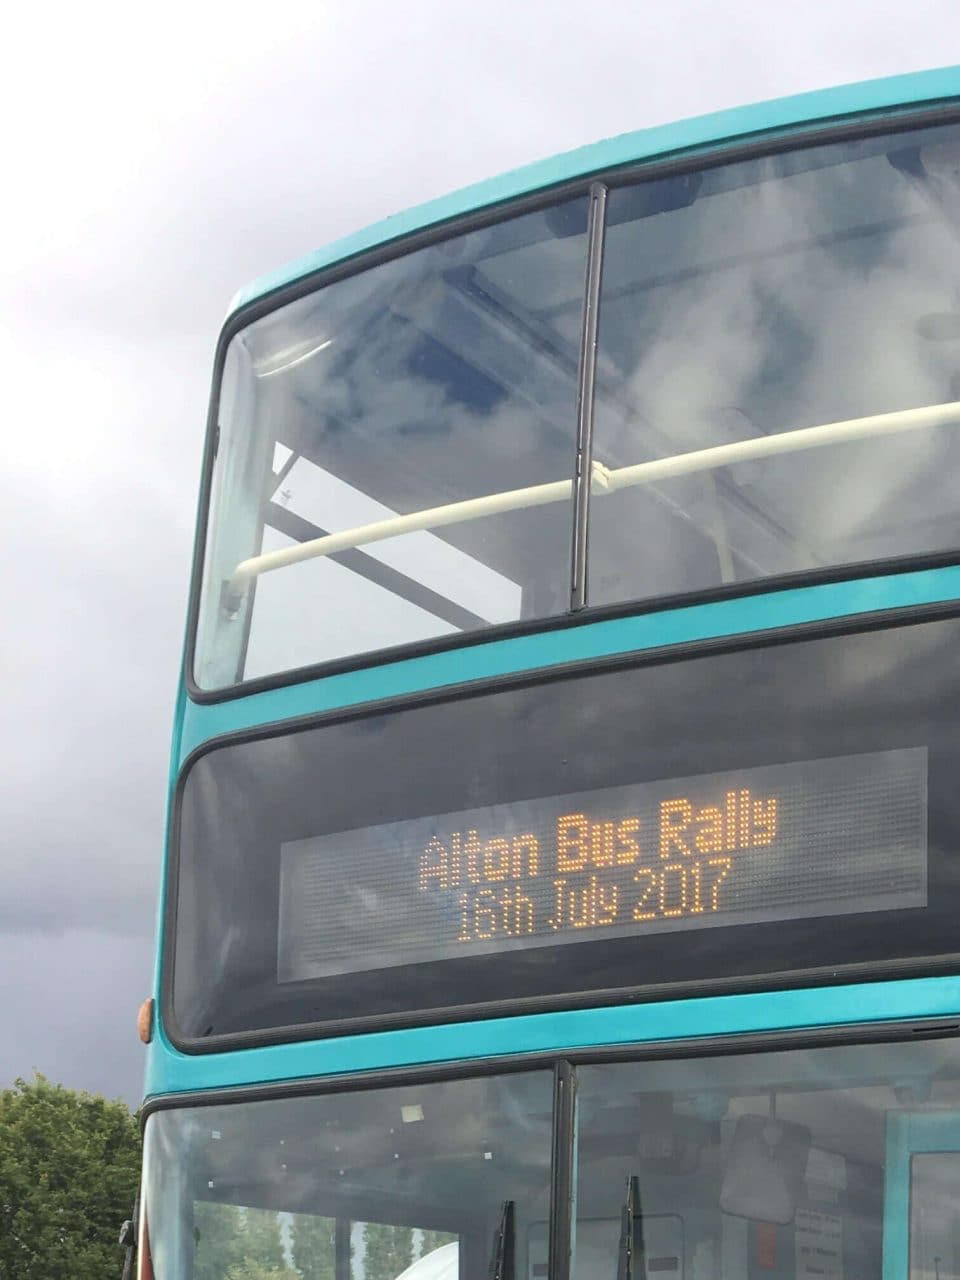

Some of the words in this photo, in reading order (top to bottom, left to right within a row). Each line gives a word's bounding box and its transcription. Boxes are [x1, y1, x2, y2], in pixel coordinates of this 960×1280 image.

[418, 829, 539, 891] Alton
[556, 813, 641, 873] Bus
[659, 788, 778, 859] Rally
[457, 886, 535, 943] 16th
[547, 874, 618, 931] July
[633, 857, 732, 921] 2017
